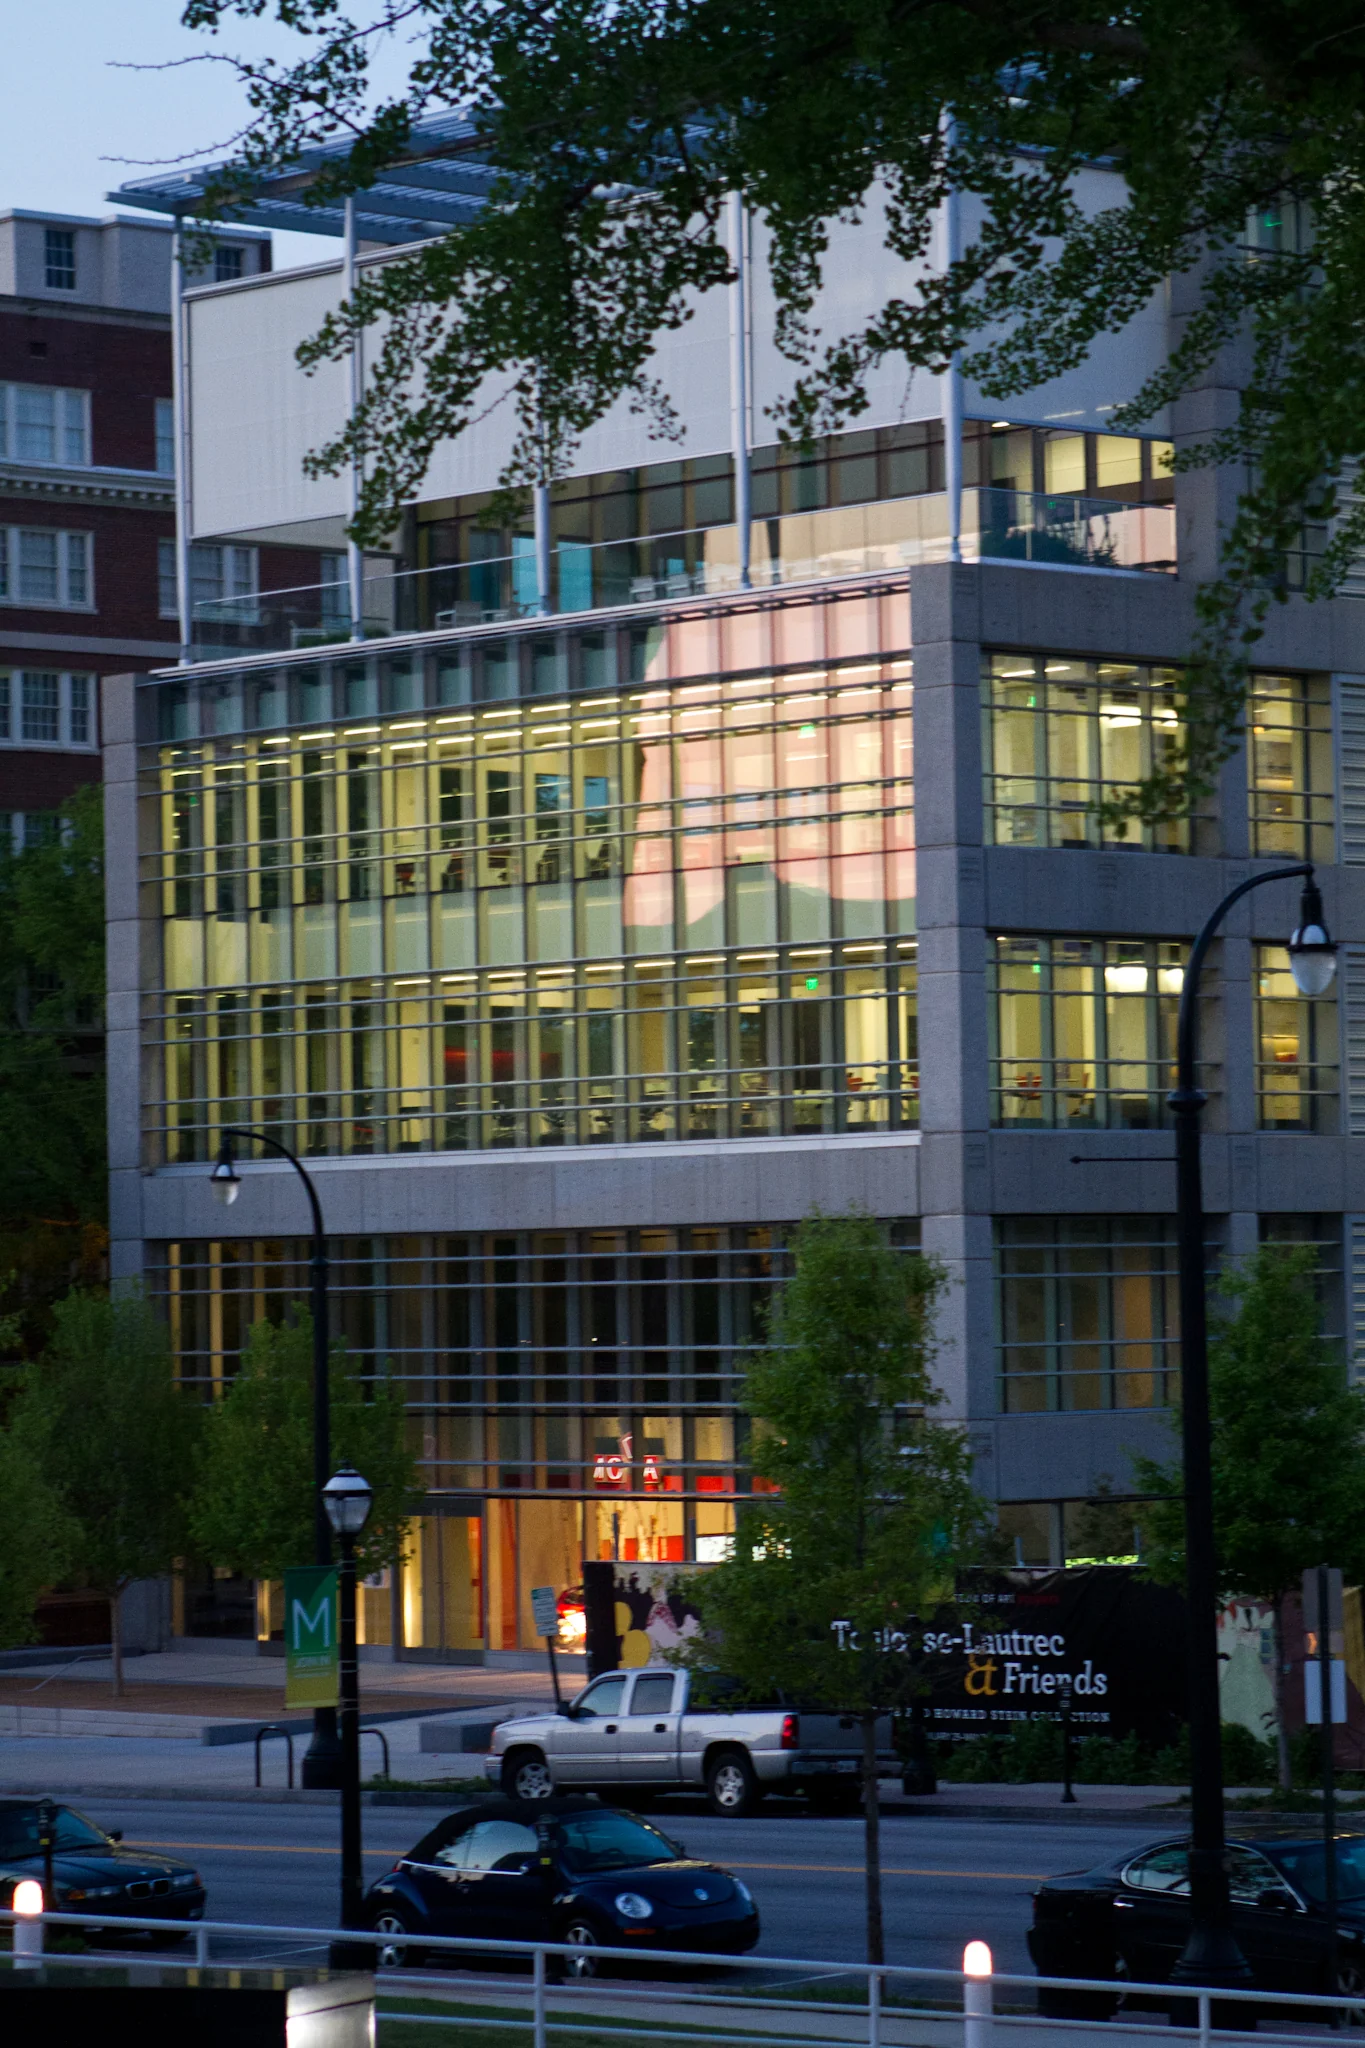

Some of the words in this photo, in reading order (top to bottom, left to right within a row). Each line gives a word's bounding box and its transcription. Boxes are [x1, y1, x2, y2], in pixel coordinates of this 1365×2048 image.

[292, 1597, 330, 1649] M
[830, 1620, 1066, 1657] Tolose-Lautrec
[1001, 1659, 1109, 1696] Friends
[932, 1708, 988, 1721] HOWARD
[989, 1709, 1028, 1721] STEIN
[1030, 1710, 1111, 1723] CLLCTION
